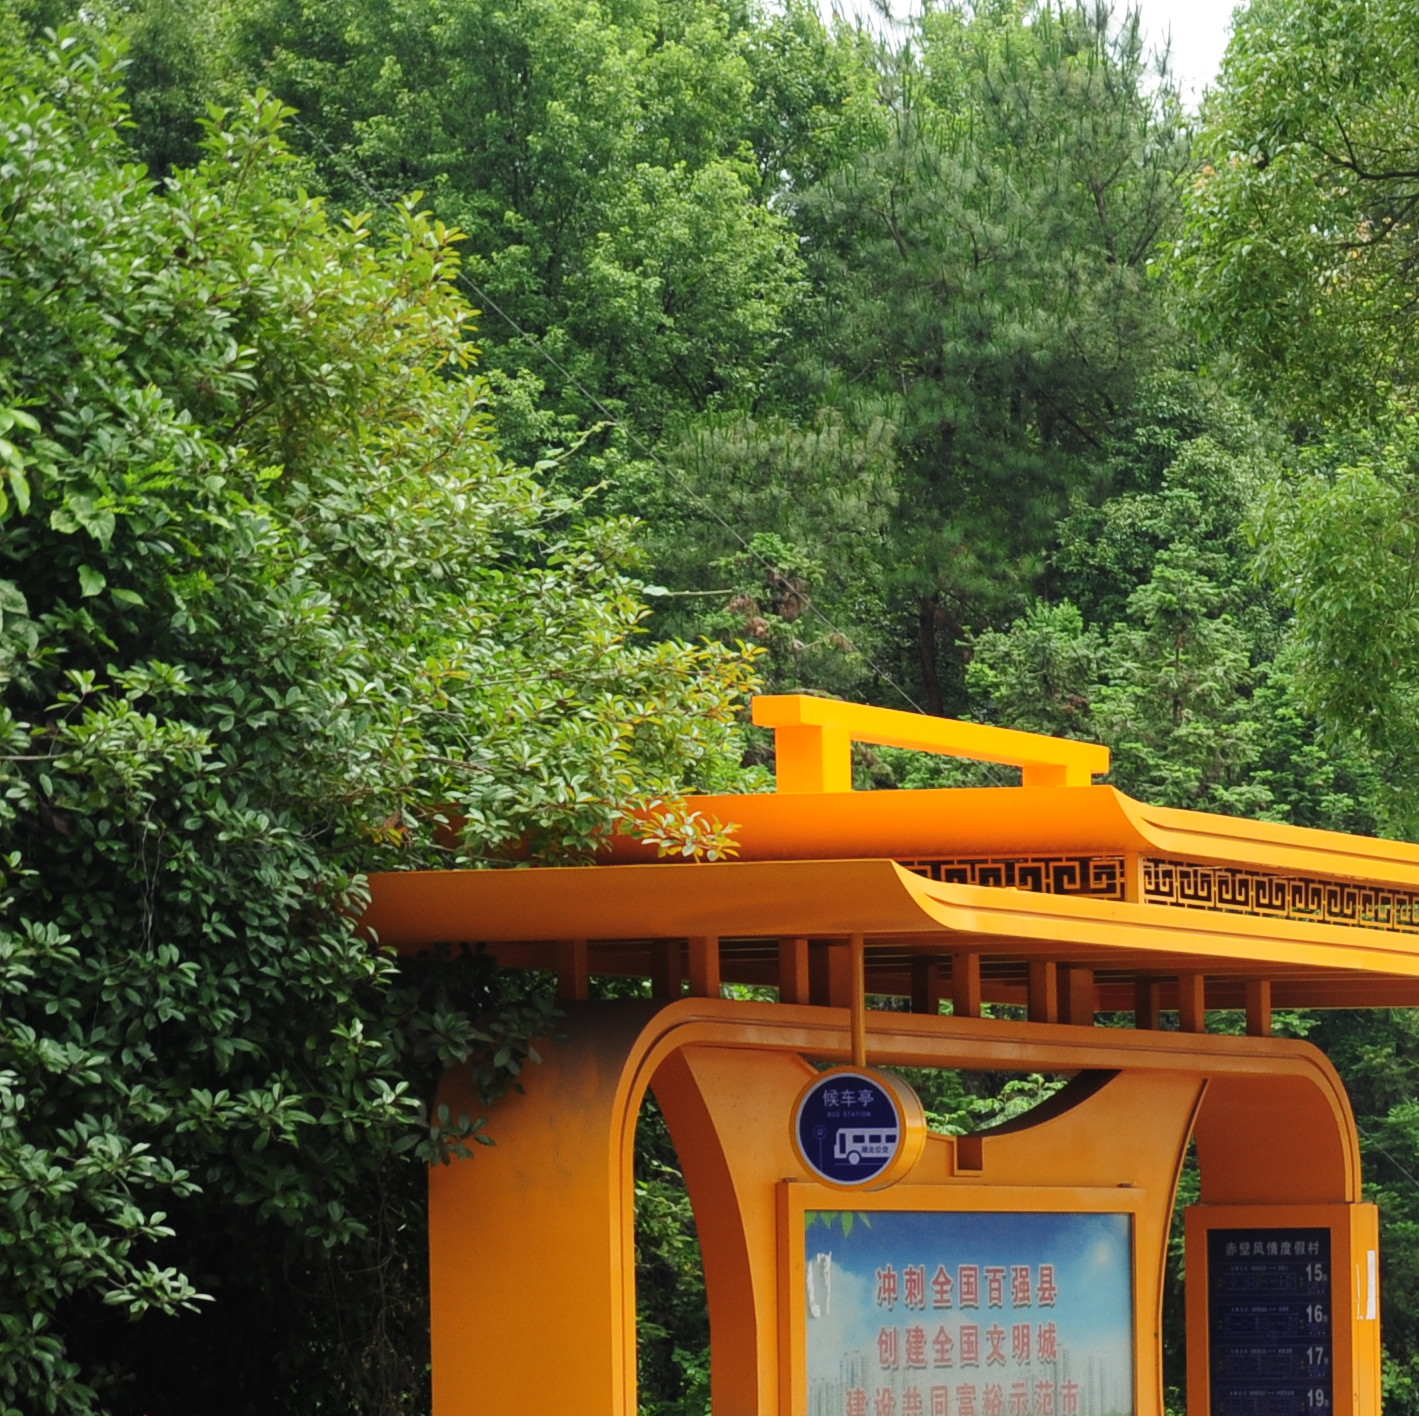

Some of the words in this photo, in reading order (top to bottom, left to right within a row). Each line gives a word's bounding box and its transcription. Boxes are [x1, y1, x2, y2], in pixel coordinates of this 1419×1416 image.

[823, 1089, 875, 1107] 候车亭
[1225, 1240, 1320, 1256] 赤壁风情度假村
[875, 1262, 1058, 1309] 冲刺全国百强县
[876, 1321, 1059, 1369] 创建全国文明城
